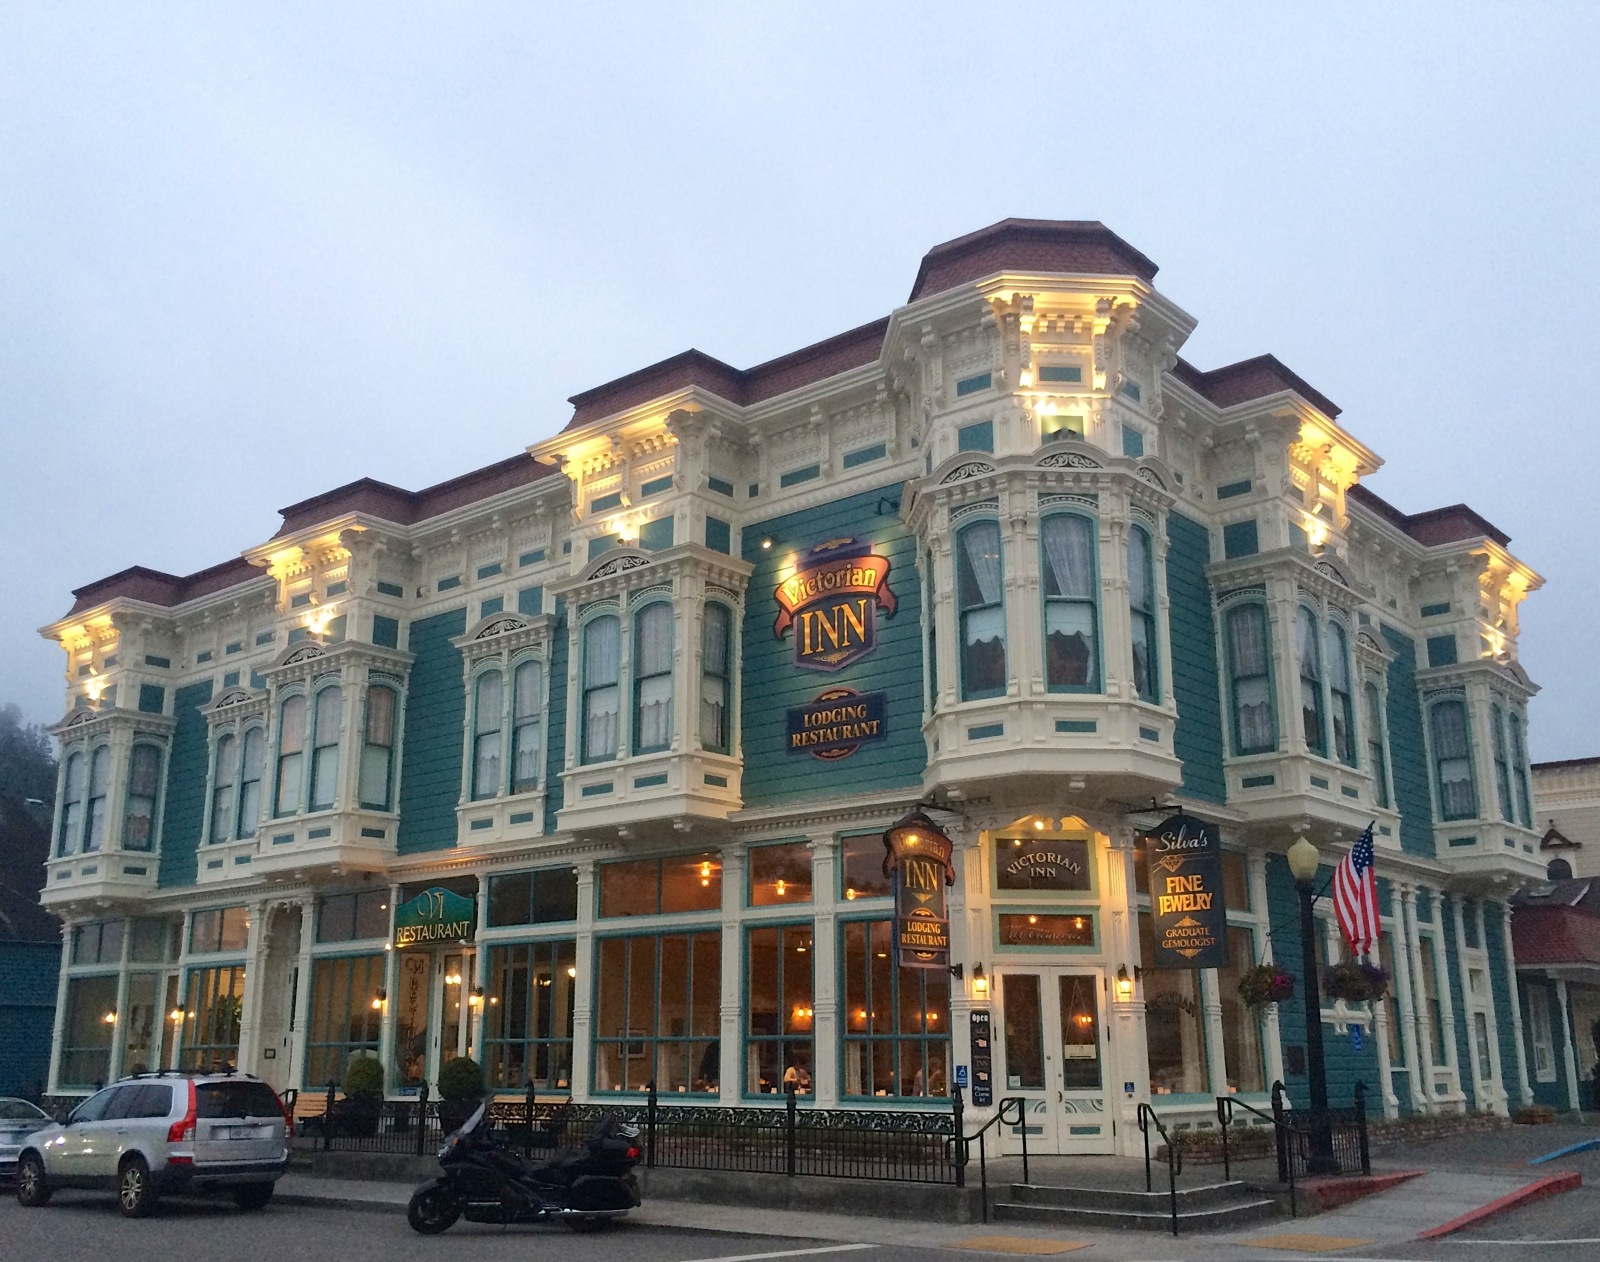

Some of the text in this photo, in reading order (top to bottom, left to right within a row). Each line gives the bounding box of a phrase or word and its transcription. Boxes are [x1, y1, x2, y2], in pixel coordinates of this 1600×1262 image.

[781, 563, 877, 606] Victorian
[801, 599, 867, 656] INN
[803, 704, 867, 728] LODGING
[791, 719, 881, 748] RESTAURANT
[1155, 824, 1208, 852] Silva's
[1007, 852, 1081, 876] VICTORIAN
[1030, 867, 1056, 877] INN
[904, 859, 938, 892] INN
[1165, 874, 1203, 894] FINE
[1158, 892, 1213, 917] JEWELRY
[396, 921, 471, 942] RESTAURANT
[907, 921, 941, 934] LODGING
[1165, 927, 1210, 938] GRADUATE
[901, 933, 947, 947] RESTAURANT
[1162, 937, 1216, 949] GEMOLOGIST
[972, 1014, 989, 1024] Open
